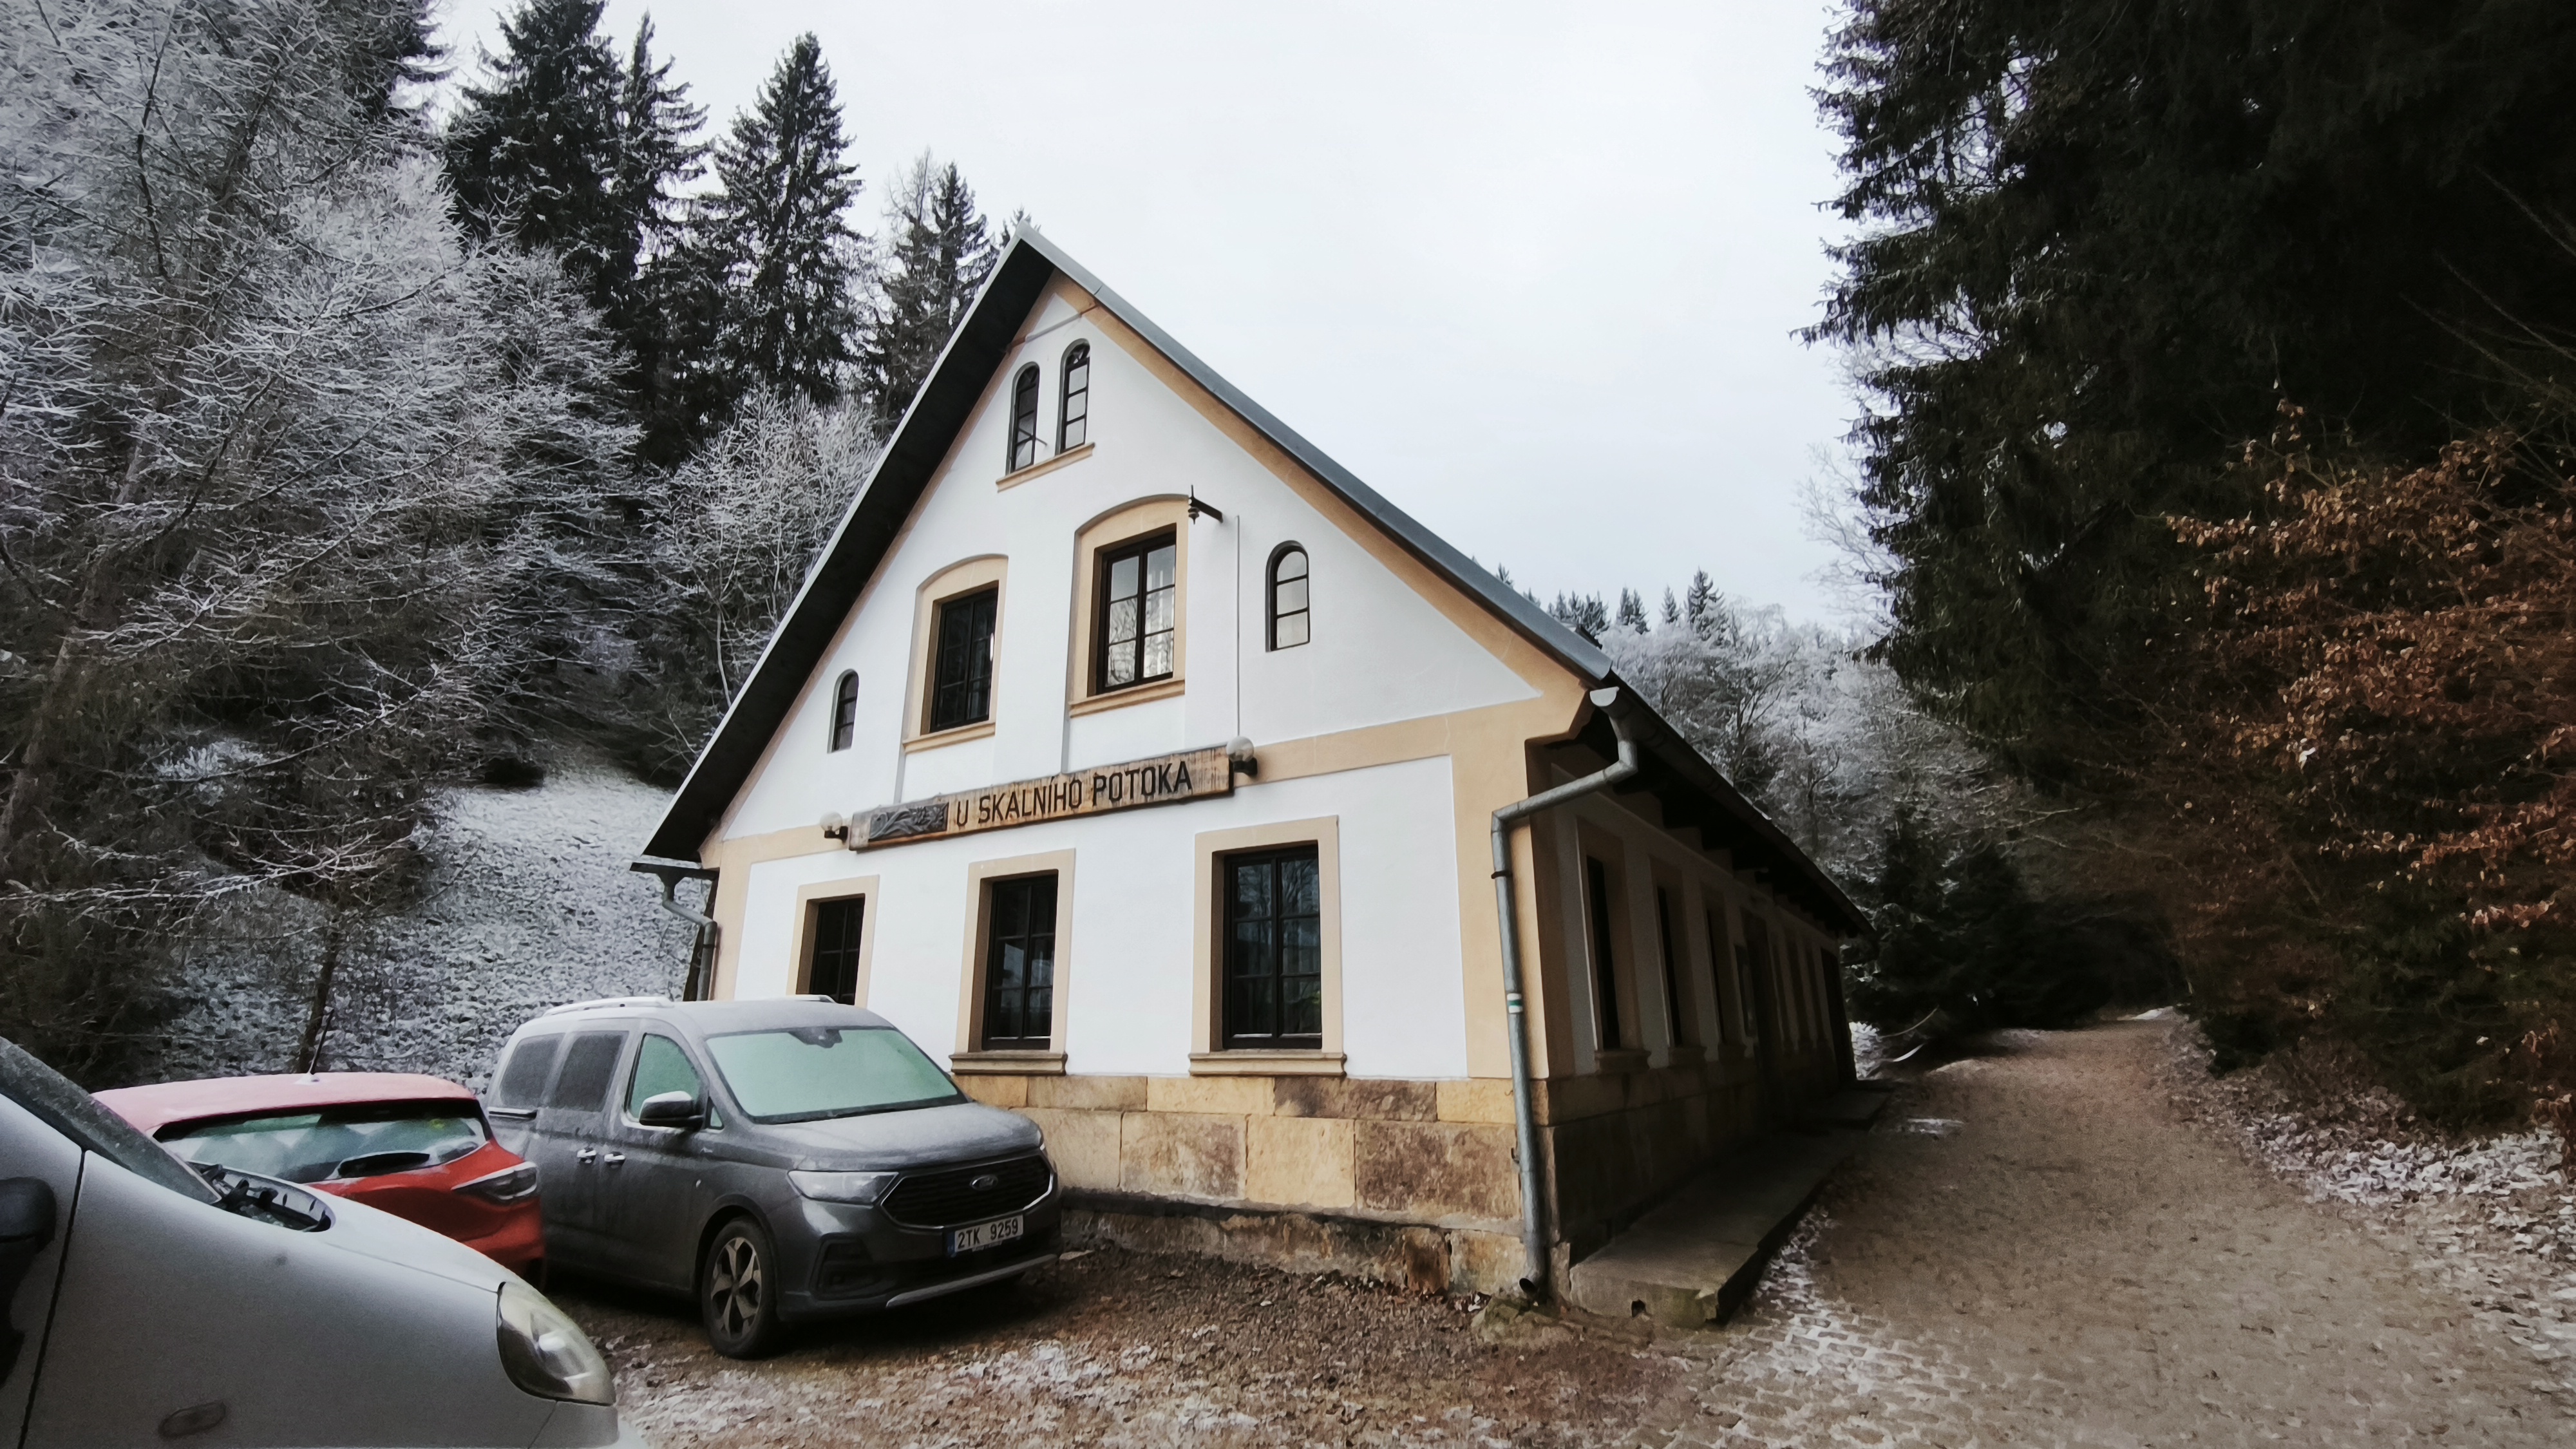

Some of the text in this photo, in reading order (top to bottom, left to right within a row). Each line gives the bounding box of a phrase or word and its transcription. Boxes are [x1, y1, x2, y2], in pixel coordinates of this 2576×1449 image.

[956, 761, 1192, 827] U SKALNÍHO POTOKA
[958, 1227, 980, 1249] 2TK
[990, 1218, 1018, 1240] 9259
